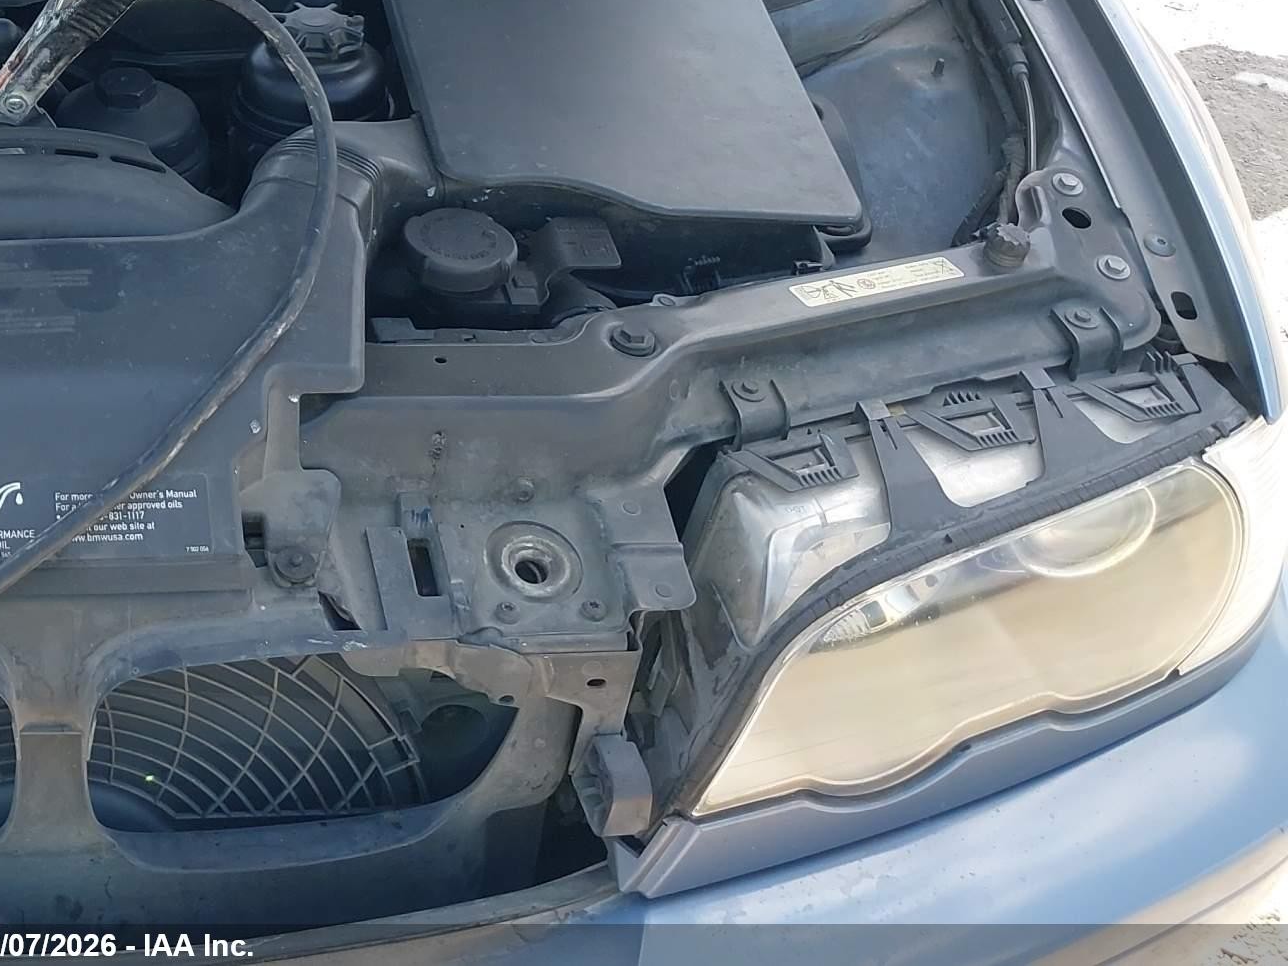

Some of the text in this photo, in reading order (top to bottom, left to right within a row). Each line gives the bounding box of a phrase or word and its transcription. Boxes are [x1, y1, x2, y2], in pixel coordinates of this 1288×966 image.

[55, 492, 69, 501] For
[165, 489, 197, 499] Manual
[55, 502, 70, 512] For
[127, 500, 166, 511] approved
[167, 499, 183, 509] oils
[93, 523, 108, 531] our
[109, 521, 128, 531] web
[129, 521, 145, 531] site
[146, 520, 155, 530] at
